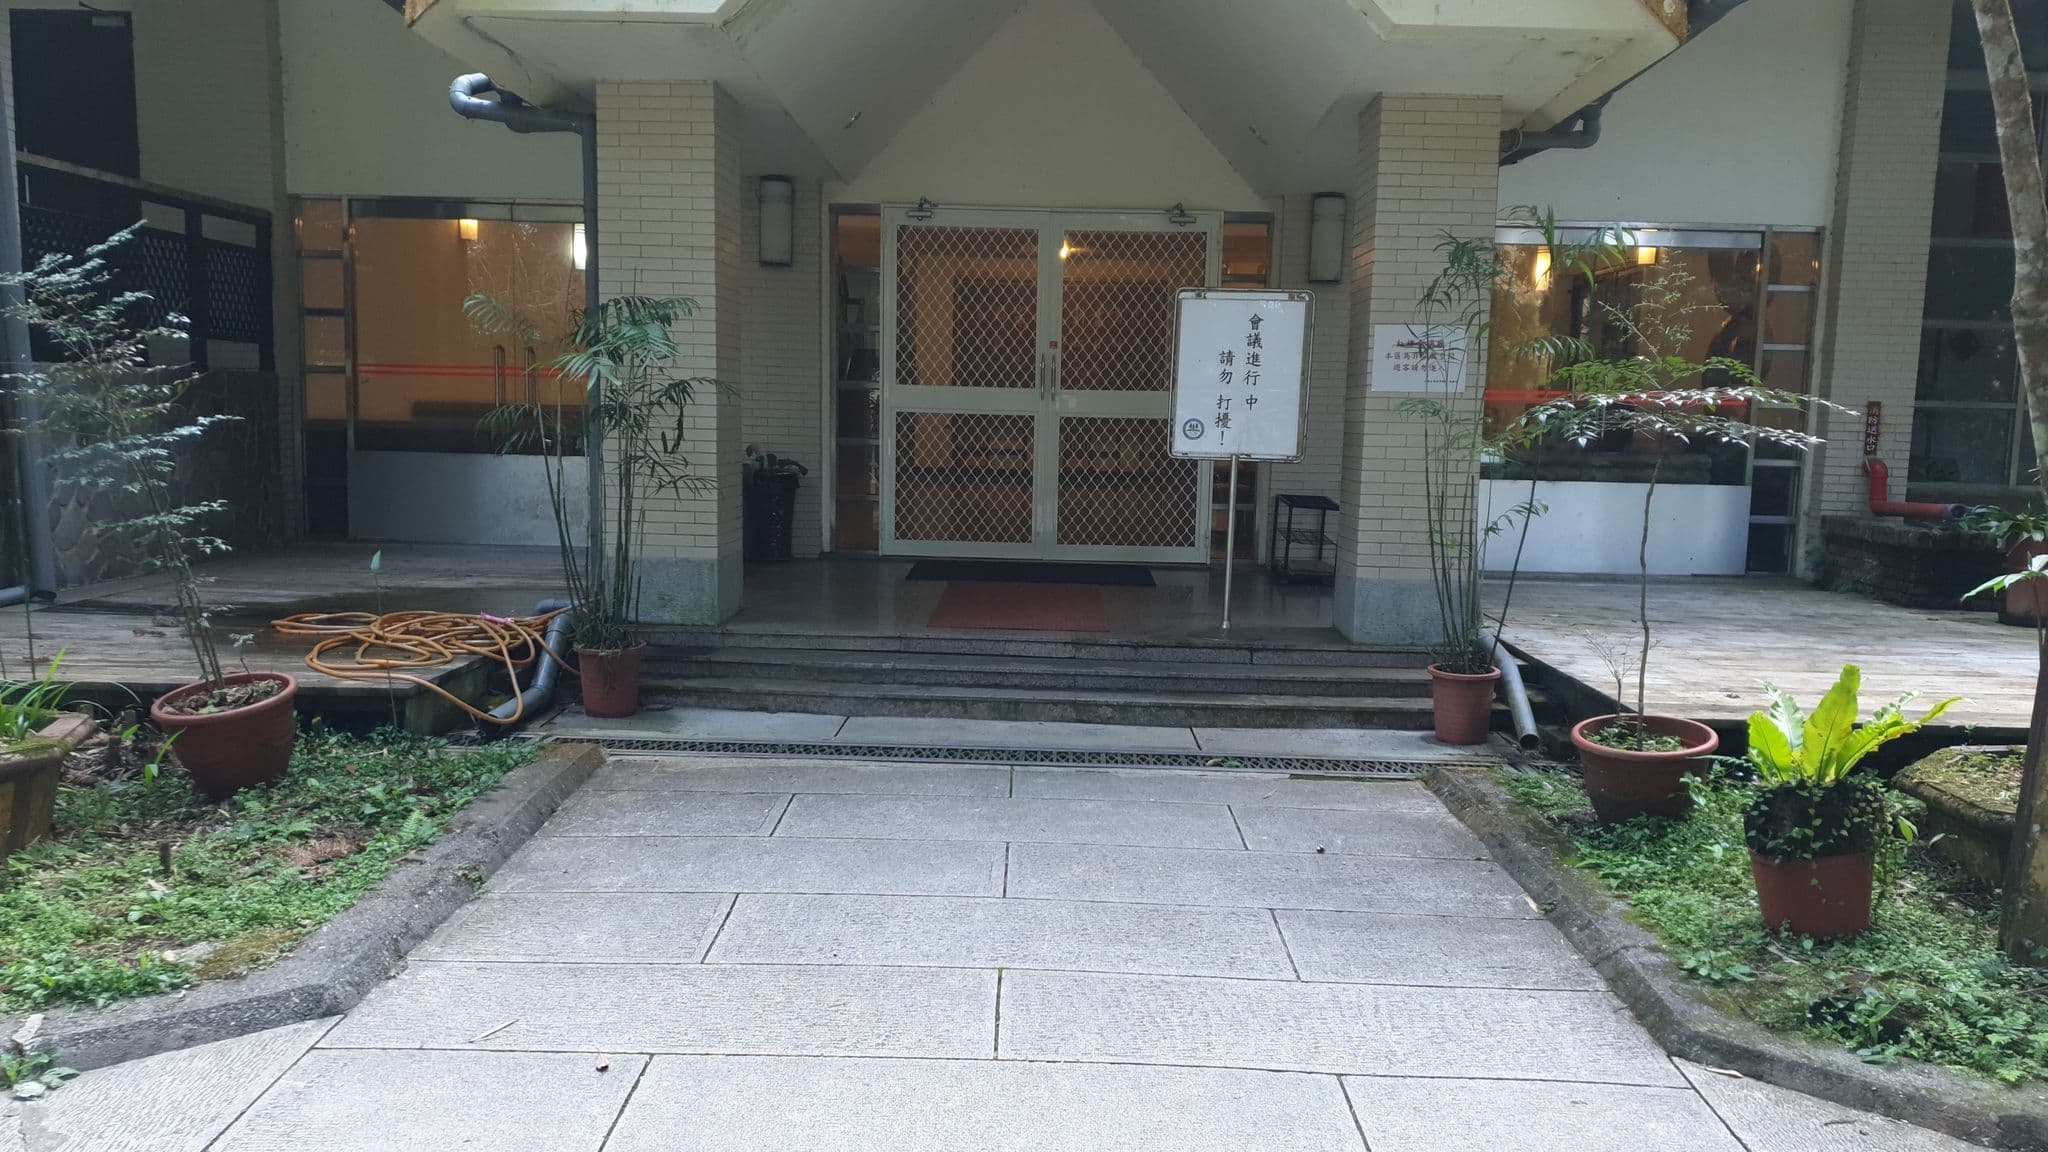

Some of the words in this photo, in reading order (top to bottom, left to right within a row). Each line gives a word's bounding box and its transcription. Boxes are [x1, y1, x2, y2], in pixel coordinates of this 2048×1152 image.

[1243, 313, 1264, 411] 會議進行中
